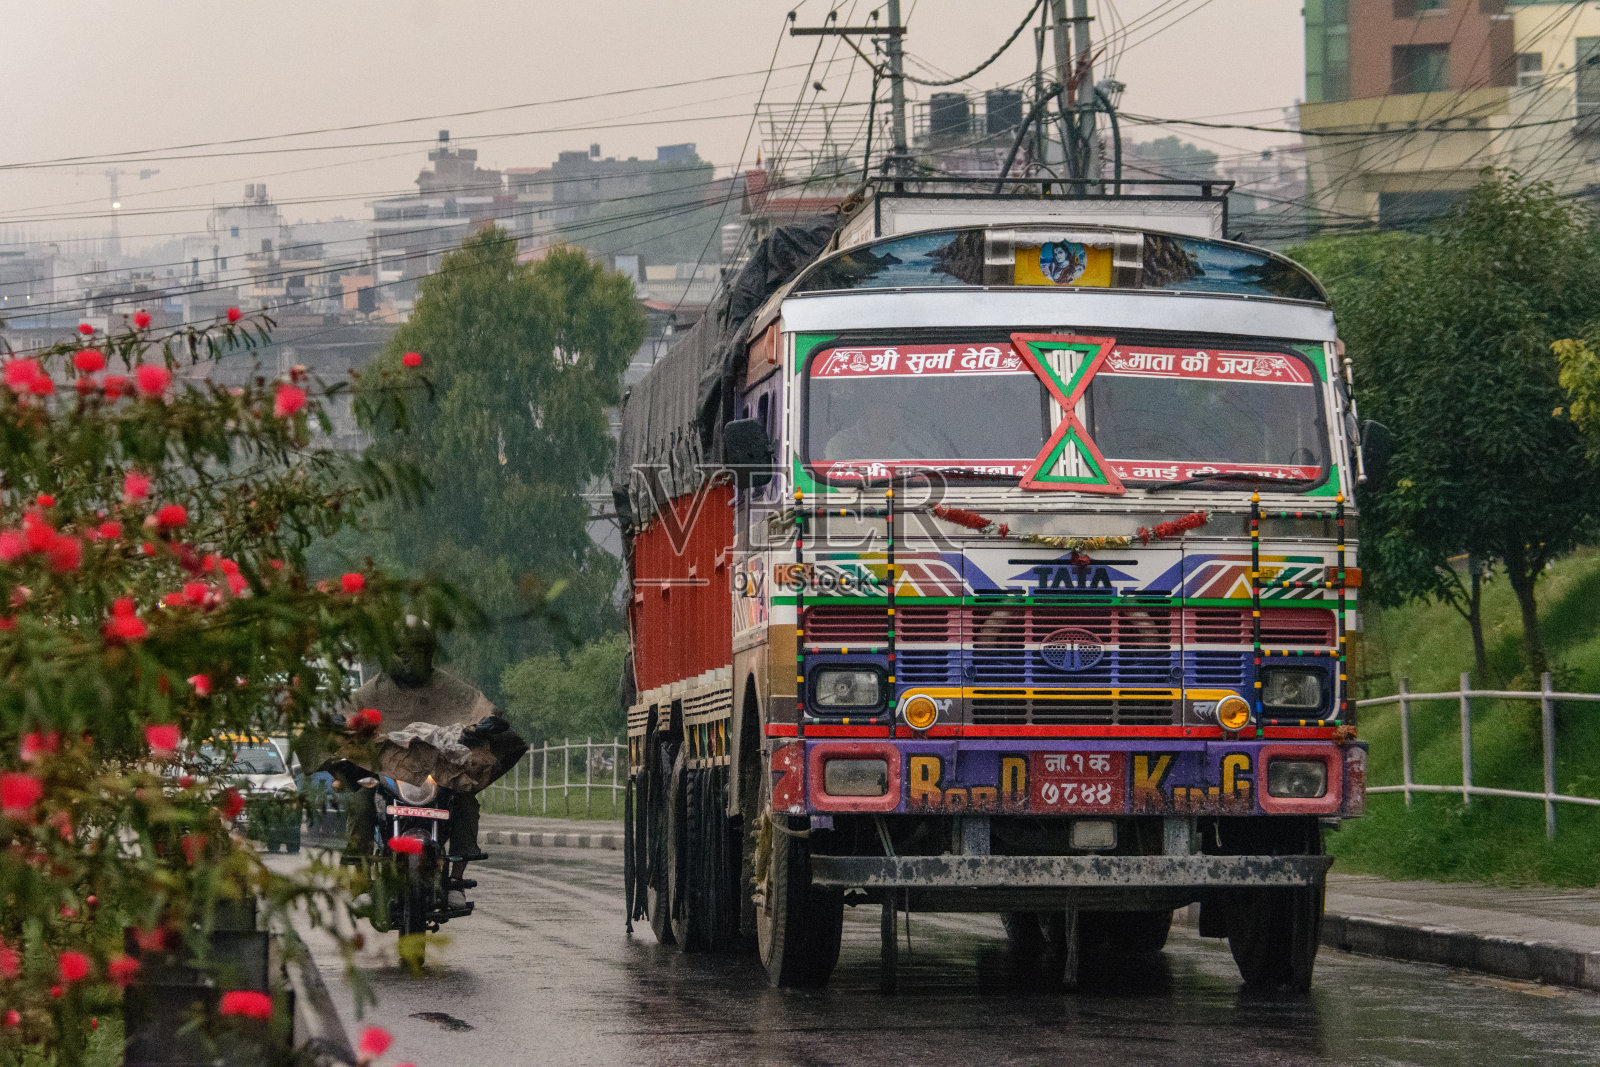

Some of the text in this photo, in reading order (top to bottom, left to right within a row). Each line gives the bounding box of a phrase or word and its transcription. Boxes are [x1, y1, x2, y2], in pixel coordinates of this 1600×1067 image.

[869, 349, 900, 371] श्री
[960, 346, 1002, 369] देवि
[1128, 353, 1176, 371] माता
[1181, 351, 1211, 372] की
[1216, 357, 1256, 374] जय
[1033, 567, 1112, 588] TATA
[1041, 782, 1112, 804] ७८४४
